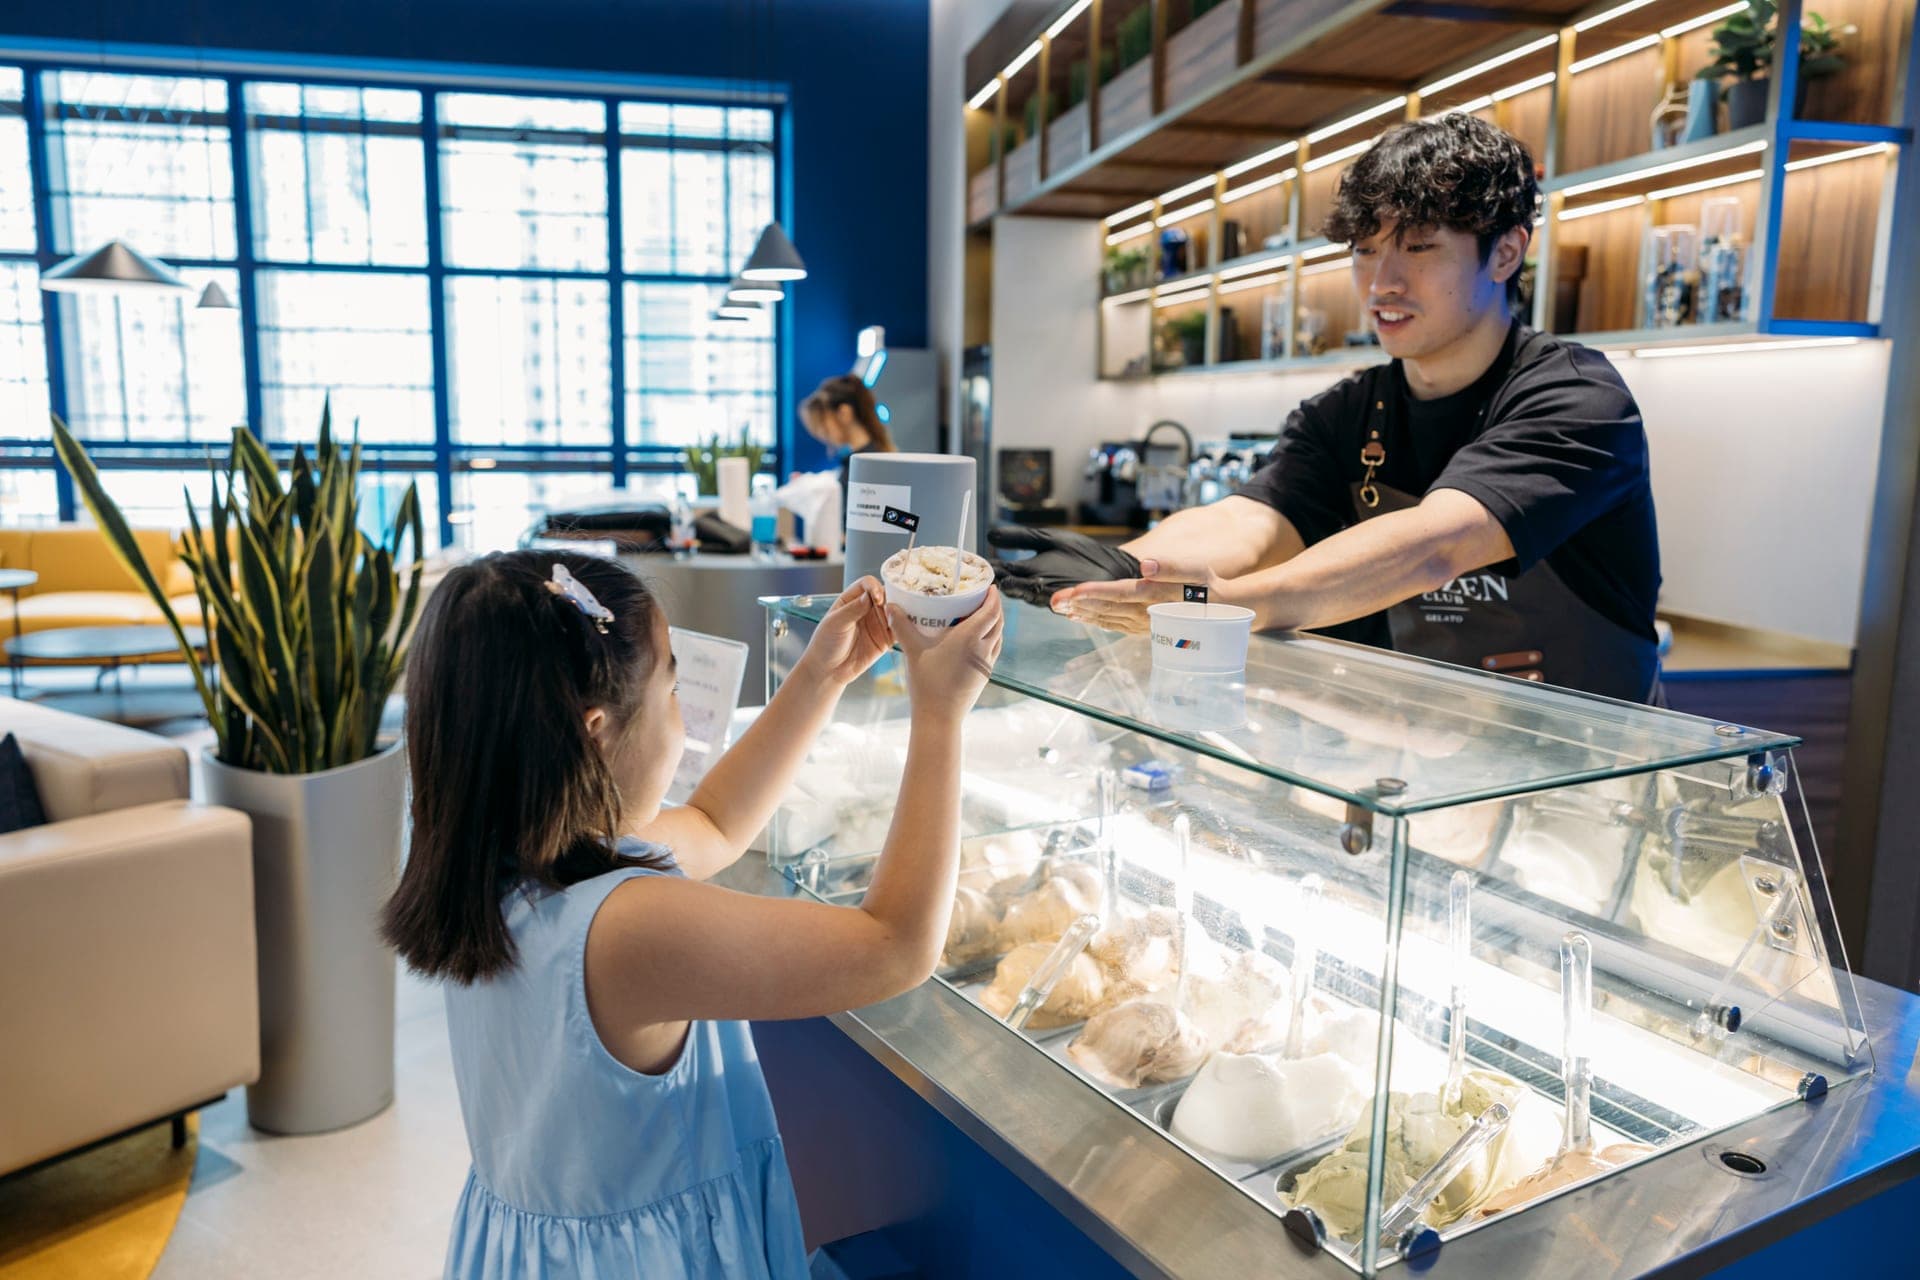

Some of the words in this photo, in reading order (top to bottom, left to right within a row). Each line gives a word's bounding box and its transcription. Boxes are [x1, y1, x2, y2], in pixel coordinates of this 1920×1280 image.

[1442, 574, 1509, 601] ZEN
[1422, 591, 1464, 605] CLUB
[920, 616, 946, 628] GEN
[1425, 614, 1464, 624] GELATO
[1156, 633, 1173, 647] GEN
